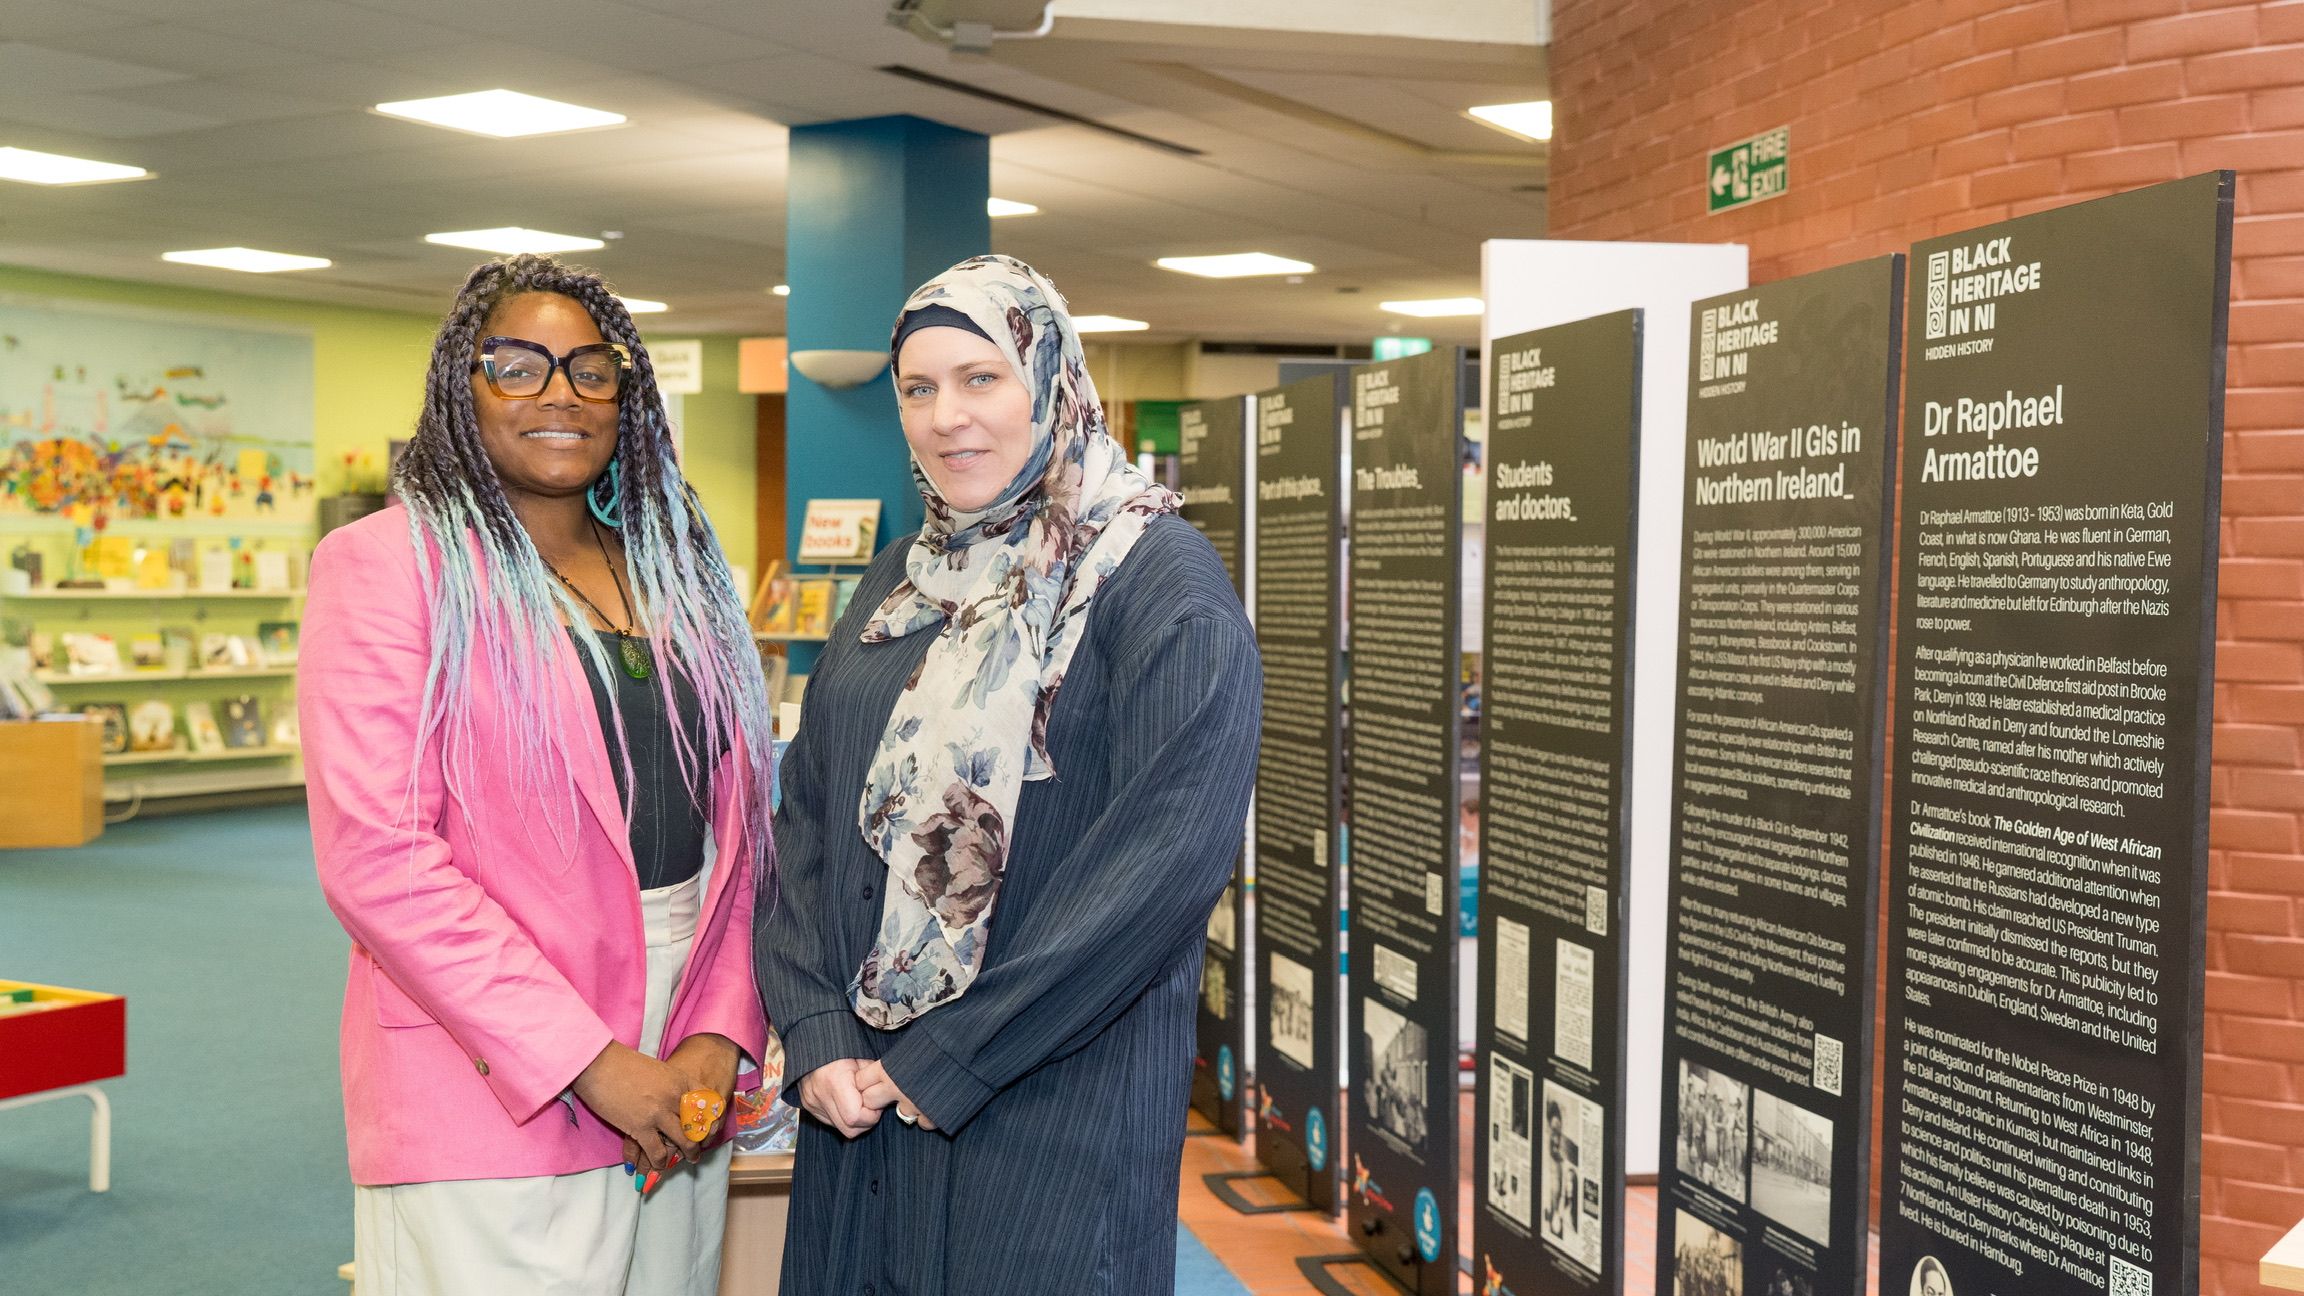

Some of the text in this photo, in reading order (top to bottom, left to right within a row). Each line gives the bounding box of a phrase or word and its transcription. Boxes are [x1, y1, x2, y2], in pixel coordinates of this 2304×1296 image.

[1751, 130, 1786, 166] FIRE
[1751, 164, 1785, 198] EXIT
[1952, 237, 2011, 274] BLACK
[1951, 262, 2041, 304] HERITAGE
[1717, 299, 1759, 328] BLACK
[1949, 303, 1995, 336] IN NI
[1717, 321, 1778, 353] HERITAGE
[1925, 338, 1994, 361] HIDDEN HISTORY
[1511, 348, 1541, 371] BLACK
[1716, 352, 1748, 378] IN NI
[1366, 370, 1389, 390] BLACK
[1510, 366, 1555, 392] HERITAGE
[1699, 380, 1746, 398] HIDDEN HISTORY
[1366, 386, 1400, 408] HERITAGE
[1510, 392, 1533, 413] IN NI
[1924, 384, 2063, 440] Dr Raphael
[1697, 420, 1860, 468] World War II GIs in
[1496, 460, 1553, 489] Students
[1921, 444, 2039, 483] Armattoe
[1356, 467, 1375, 491] The
[1696, 472, 1772, 506] Northern
[1496, 494, 1519, 521] and
[1919, 510, 1930, 525] Dr
[1930, 509, 1964, 527] Raphael
[1962, 509, 2002, 523] Armattoe
[2002, 506, 2029, 523] (1913
[2037, 504, 2063, 522] 1953)
[2064, 507, 2084, 521] was
[2084, 504, 2109, 520] born
[2109, 504, 2119, 519] in
[2120, 503, 2145, 520] Keta,
[2146, 501, 2173, 518] Gold
[808, 516, 842, 528] New
[1826, 525, 1862, 538] American
[804, 535, 851, 548] books
[1918, 527, 2171, 546] Coast, in what is now Ghana. He was fluent in German,
[1807, 543, 1861, 558] Around 15,000
[1918, 550, 2172, 570] French, English, Spanish, Portuguese and his native Ewe
[1825, 565, 1852, 579] serving
[1917, 573, 2170, 595] language. He travelled to Germany to study anthropology,
[1786, 582, 1860, 598] Quartermaster Corps
[1760, 599, 1776, 616] They
[1775, 602, 1793, 613] were
[1792, 601, 1824, 614] stationed
[1832, 603, 1859, 615] various
[1916, 594, 2169, 617] literature and medicine but left for Edinburgh after the Nazis
[1831, 620, 1857, 636] Belfast,
[1916, 617, 1972, 632] rose to power.
[1912, 709, 2165, 749] on Northland Road in Derry and founded the Lomeshie
[1912, 728, 2164, 777] Research Centre, named after his mother which actively
[1910, 800, 2162, 859] Dr Armattoe's book The Golden Age of West African
[1904, 1016, 2156, 1118] He was nominated for the Nobel Peace Prize in 1948 by
